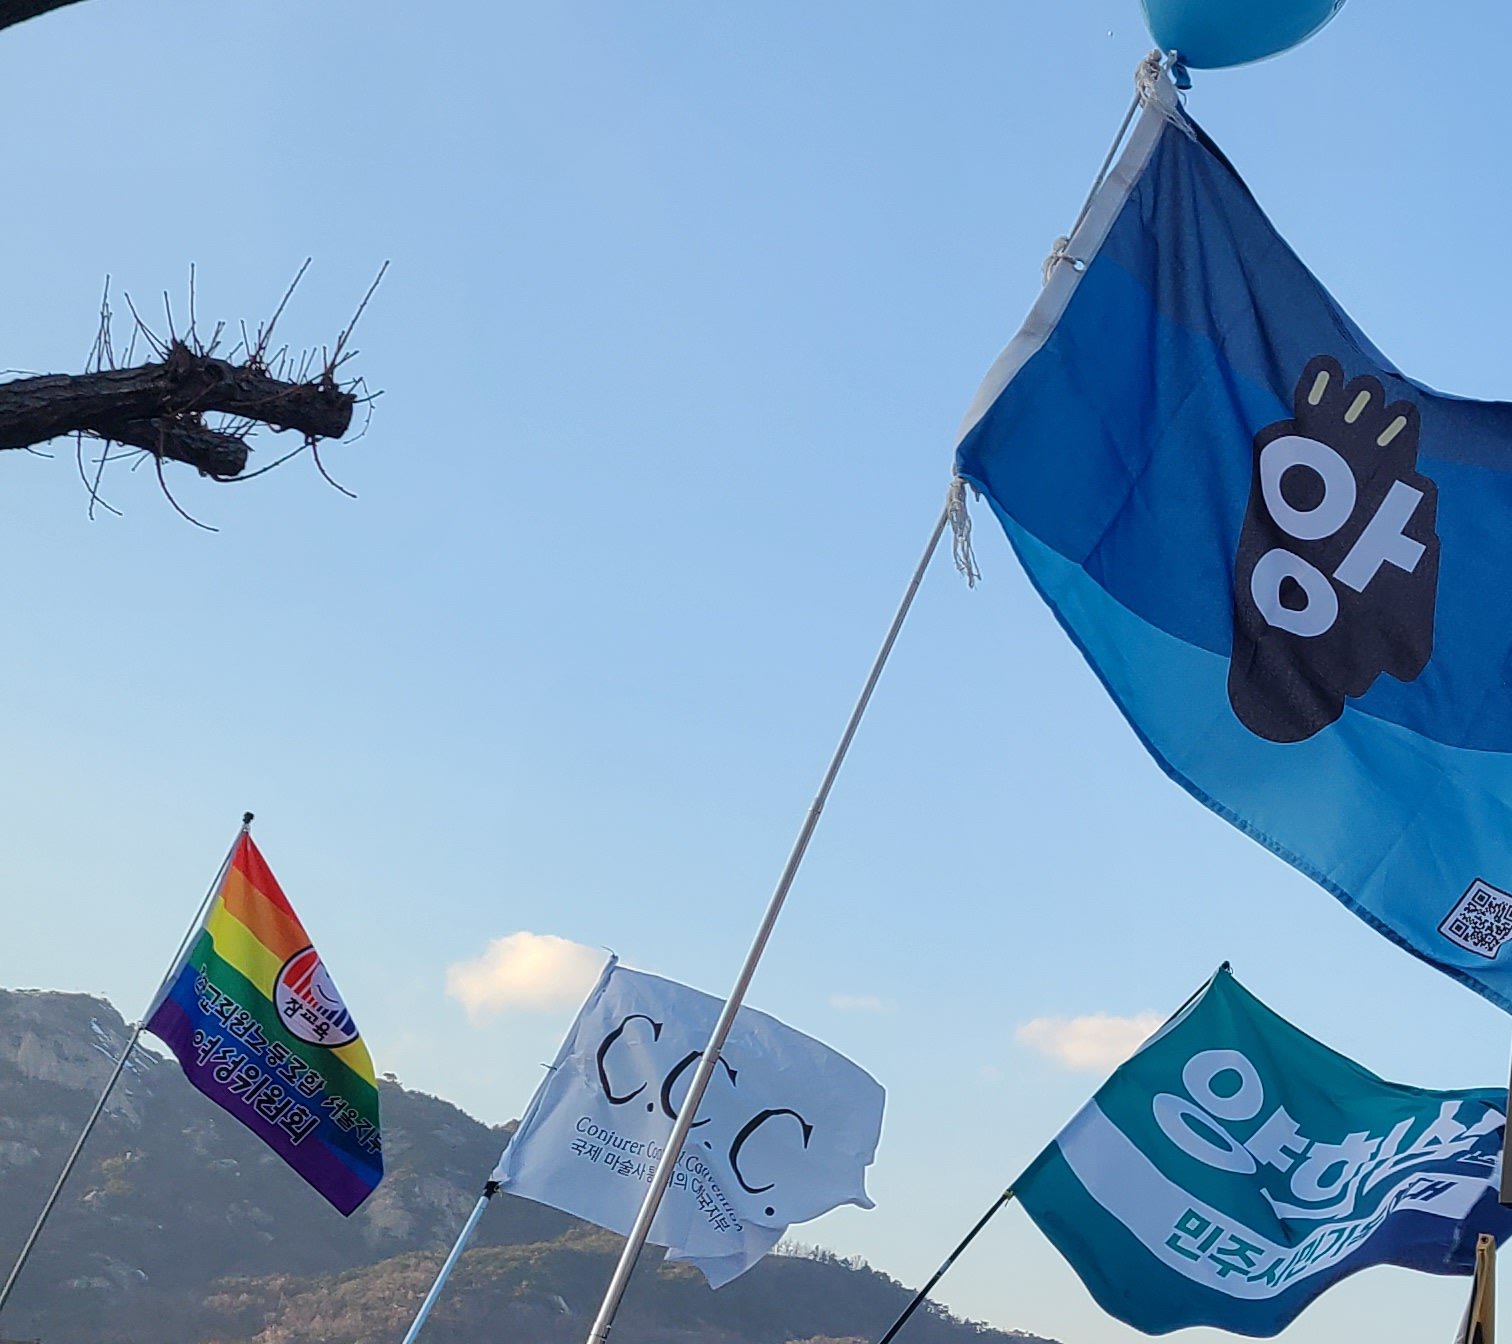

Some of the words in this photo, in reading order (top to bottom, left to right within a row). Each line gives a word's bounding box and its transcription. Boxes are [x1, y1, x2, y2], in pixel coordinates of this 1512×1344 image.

[284, 997, 331, 1042] 참교육
[193, 1029, 321, 1146] 여성위원회
[576, 1116, 646, 1156] Conjurer
[571, 1137, 603, 1163] 국제
[603, 1152, 646, 1181] 마술사
